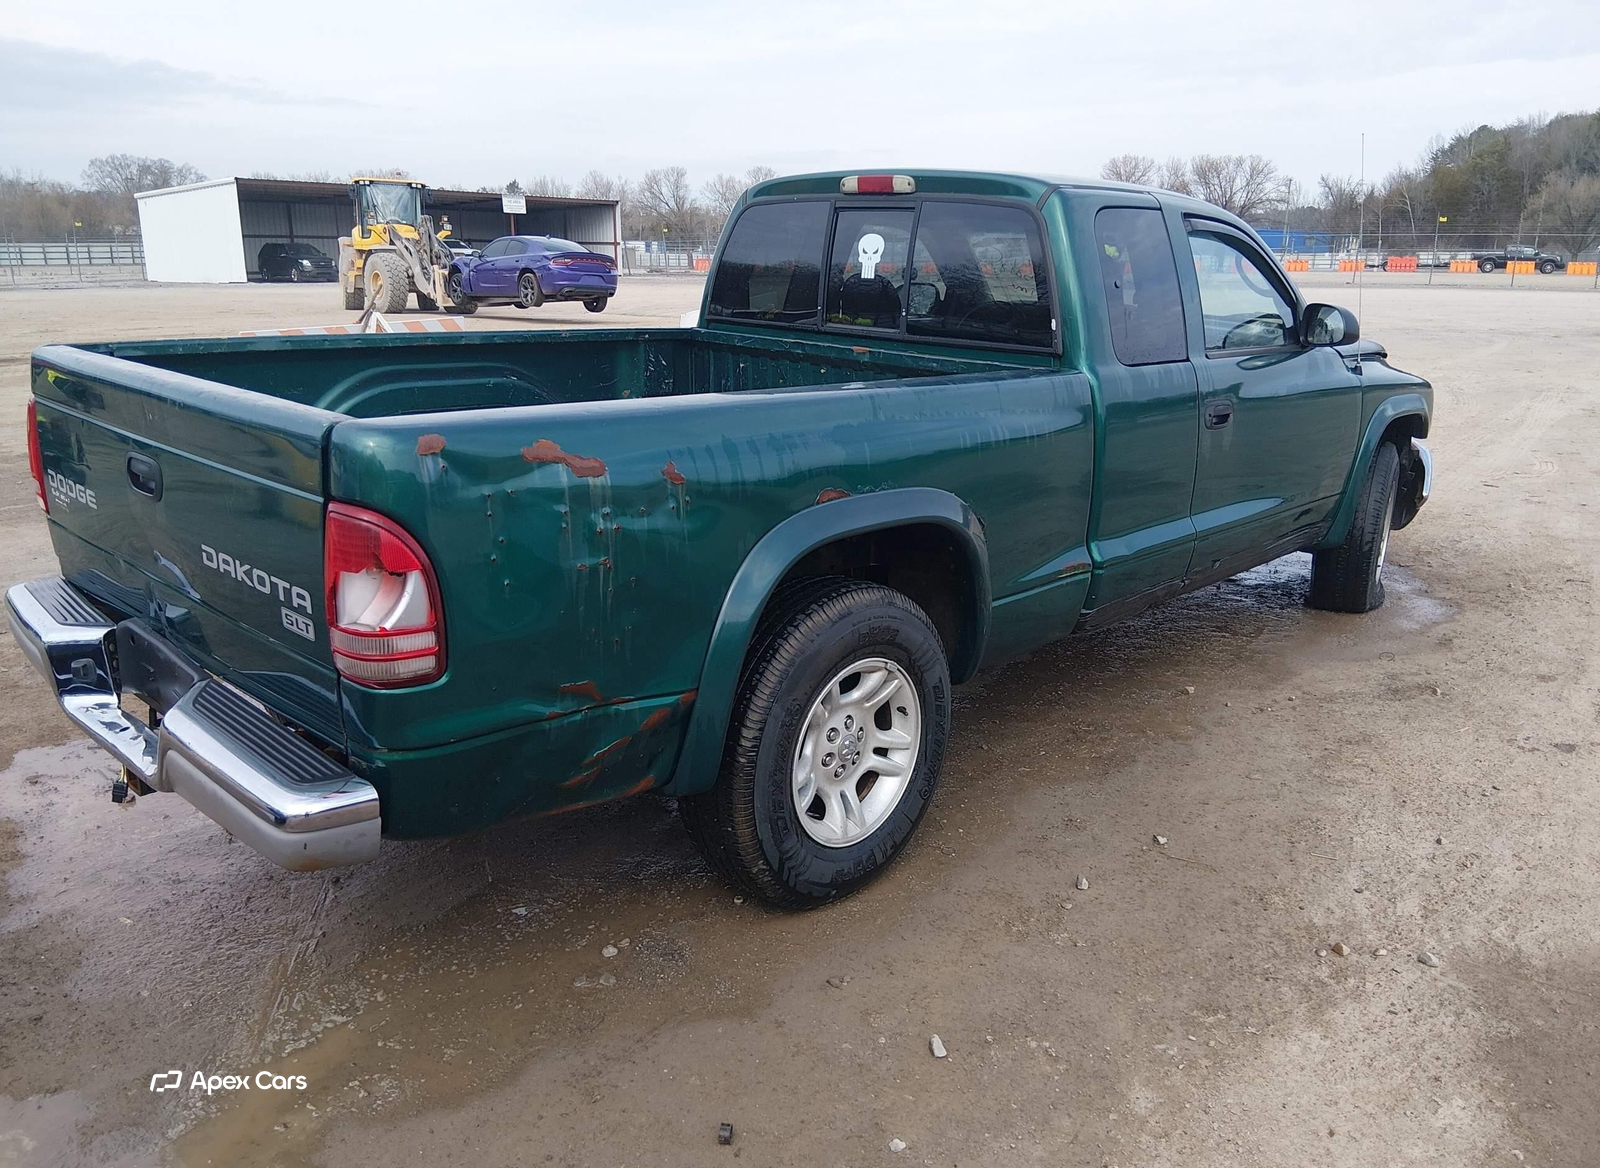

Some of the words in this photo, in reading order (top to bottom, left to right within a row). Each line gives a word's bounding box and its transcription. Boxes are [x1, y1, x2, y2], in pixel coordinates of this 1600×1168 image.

[47, 468, 98, 510] DODGE
[201, 544, 313, 614] DAKOTA
[284, 612, 312, 636] SLT
